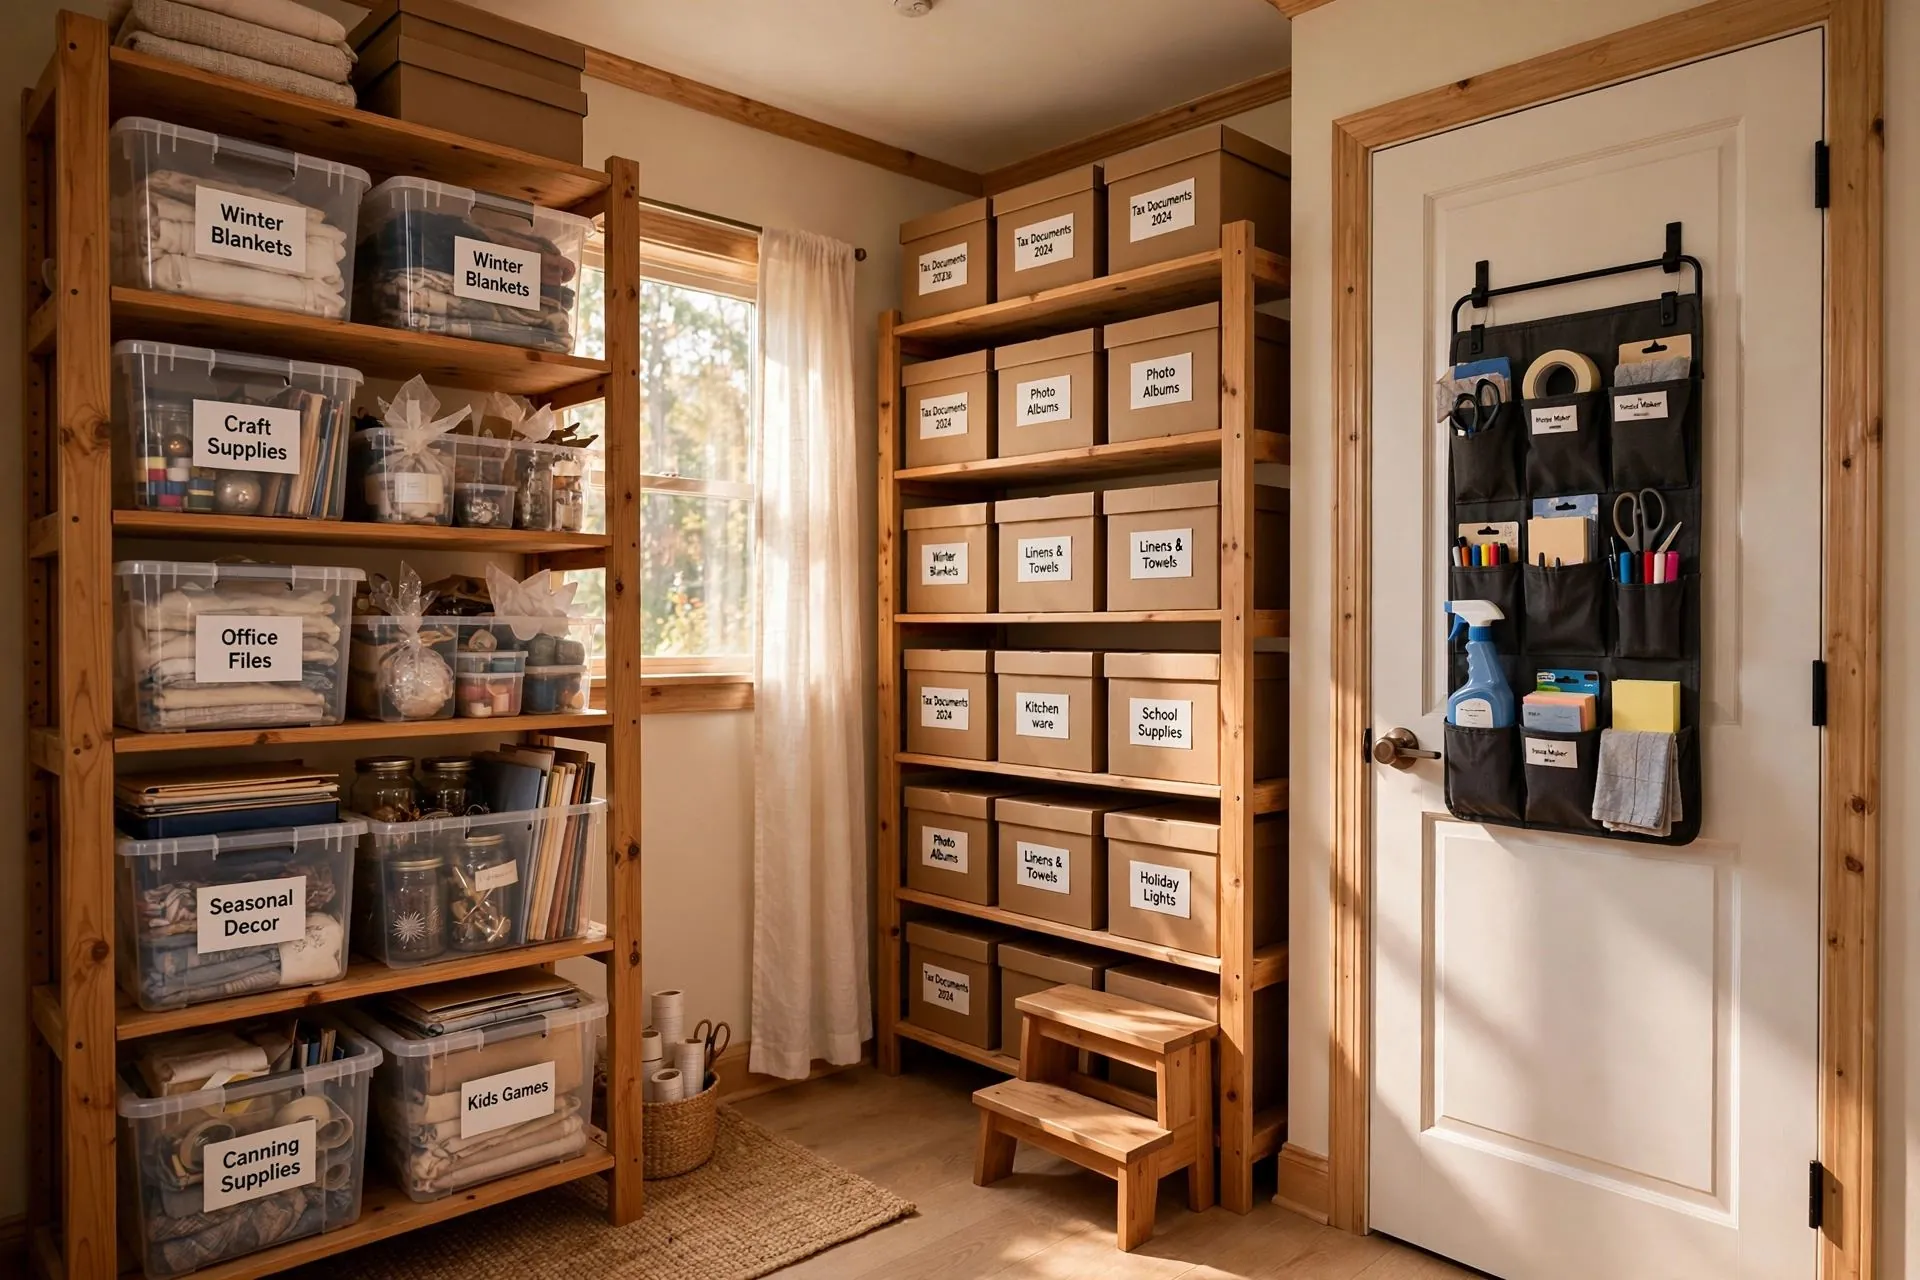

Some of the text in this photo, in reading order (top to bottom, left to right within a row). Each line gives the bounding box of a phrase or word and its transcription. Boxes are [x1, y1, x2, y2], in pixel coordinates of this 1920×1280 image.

[1132, 192, 1192, 216] Tax Documents
[221, 203, 283, 231] Winter
[212, 227, 292, 256] Blankets
[1017, 225, 1071, 247] Tax Documents
[1035, 244, 1053, 257] 2024
[473, 251, 523, 273] Winter
[920, 254, 966, 272] Tax Documents
[466, 271, 529, 296] Blankets
[1147, 367, 1175, 380] Photo
[1031, 387, 1055, 399] Photo
[1143, 384, 1179, 397] Albums
[922, 403, 966, 417] Tax Documents
[1027, 403, 1058, 415] Albums
[224, 415, 271, 435] Craft
[936, 418, 951, 429] 2024
[208, 438, 287, 460] Supplies
[1026, 545, 1063, 558] Linens &
[1140, 538, 1183, 552] Linens &
[1029, 561, 1058, 573] Towels
[1143, 556, 1177, 568] Towels
[222, 629, 278, 645] Office
[229, 653, 271, 668] Files
[922, 696, 968, 707] Tax Documents
[1026, 701, 1058, 714] Kitchen
[936, 710, 952, 719] 2024
[1143, 708, 1177, 720] School
[1032, 719, 1053, 729] ware
[1139, 724, 1182, 740] Supplies
[934, 835, 955, 848] Photo
[930, 850, 958, 863] Albums
[1025, 851, 1062, 867] Linens &
[1027, 867, 1057, 883] Towels
[1141, 872, 1179, 892] Holiday
[210, 889, 293, 915] Seasonal
[1144, 889, 1176, 906] Lights
[224, 918, 279, 936] Decor
[924, 971, 968, 993] Tax Documents
[938, 990, 953, 1001] 2024
[468, 1081, 548, 1111] Kids Games
[223, 1140, 299, 1169] Canning
[221, 1162, 300, 1192] Supplies
